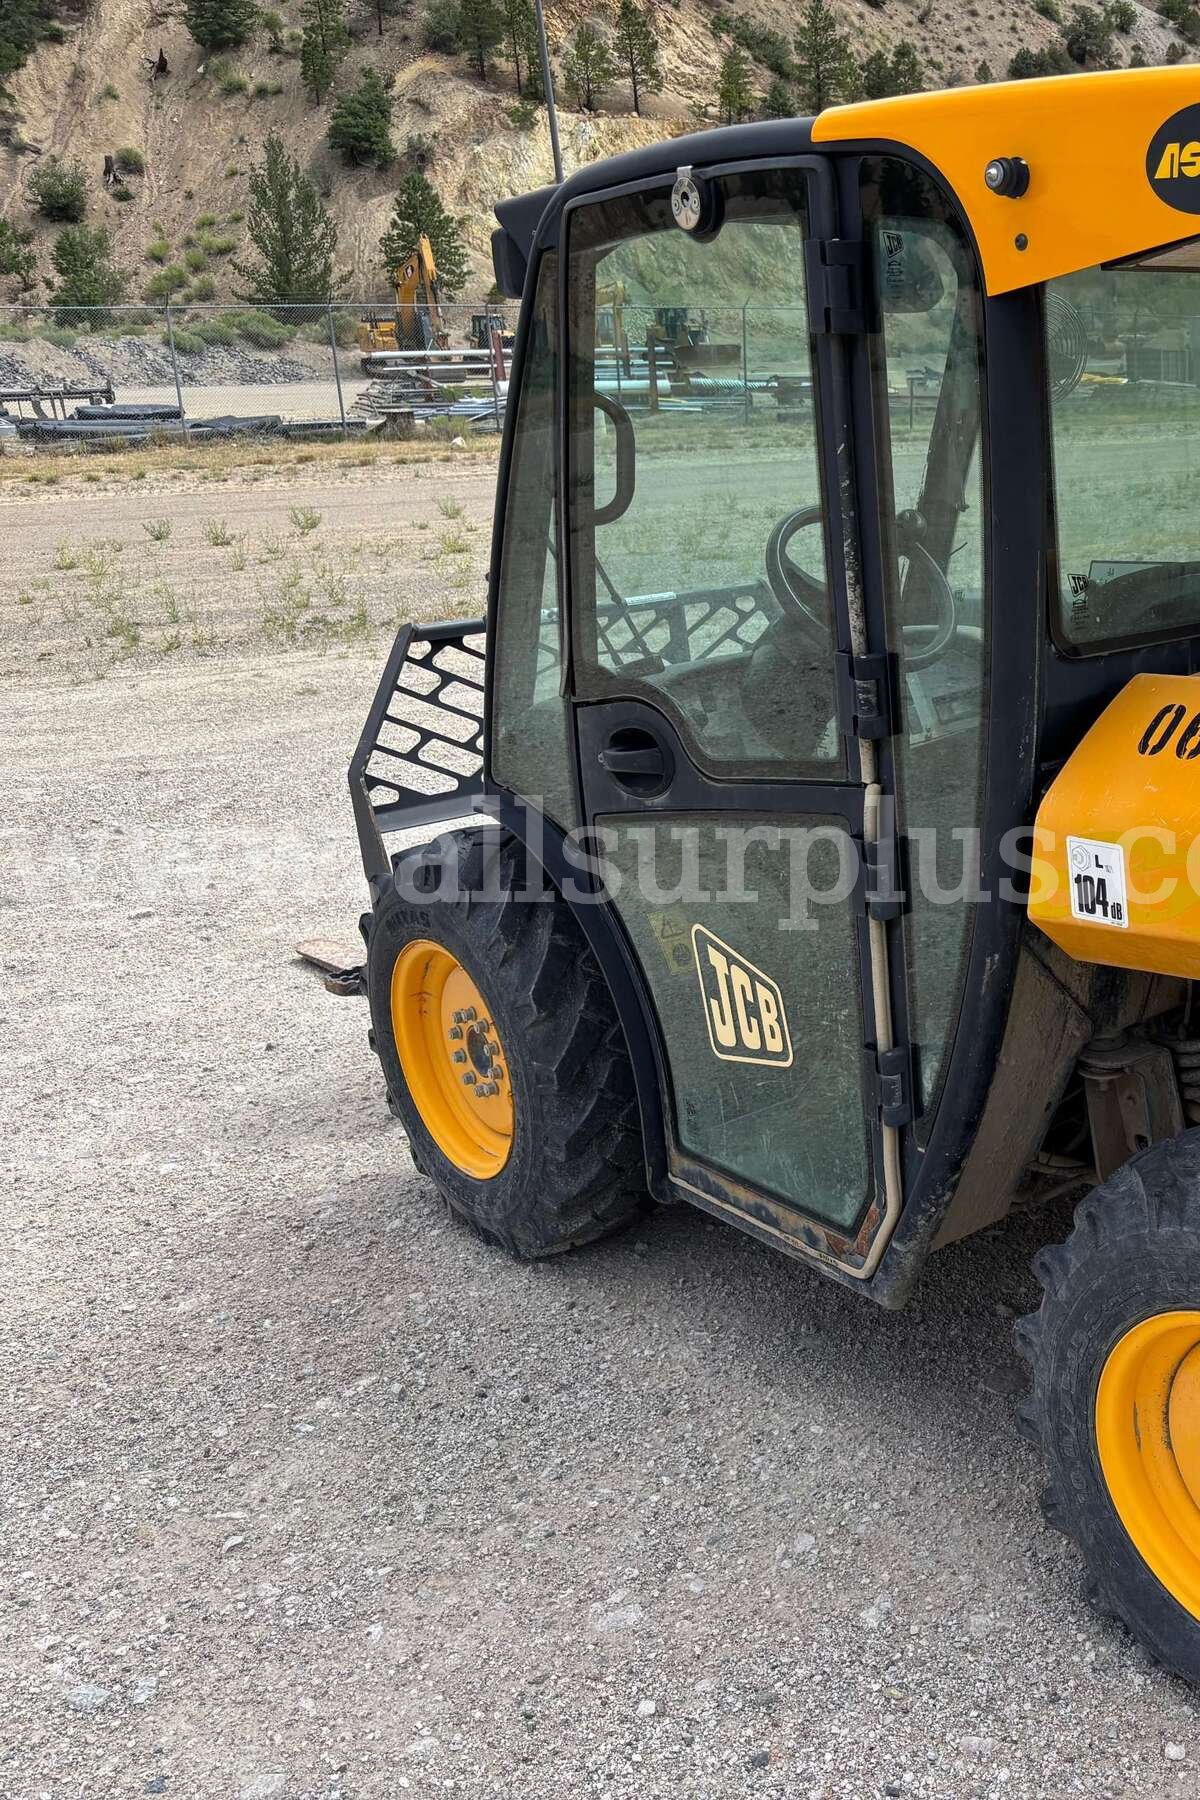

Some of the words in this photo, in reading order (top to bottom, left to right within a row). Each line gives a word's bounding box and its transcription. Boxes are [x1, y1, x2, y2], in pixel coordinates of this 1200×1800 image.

[1074, 873, 1109, 918] 104
[1111, 902, 1123, 920] dB
[707, 943, 784, 1053] JCB
